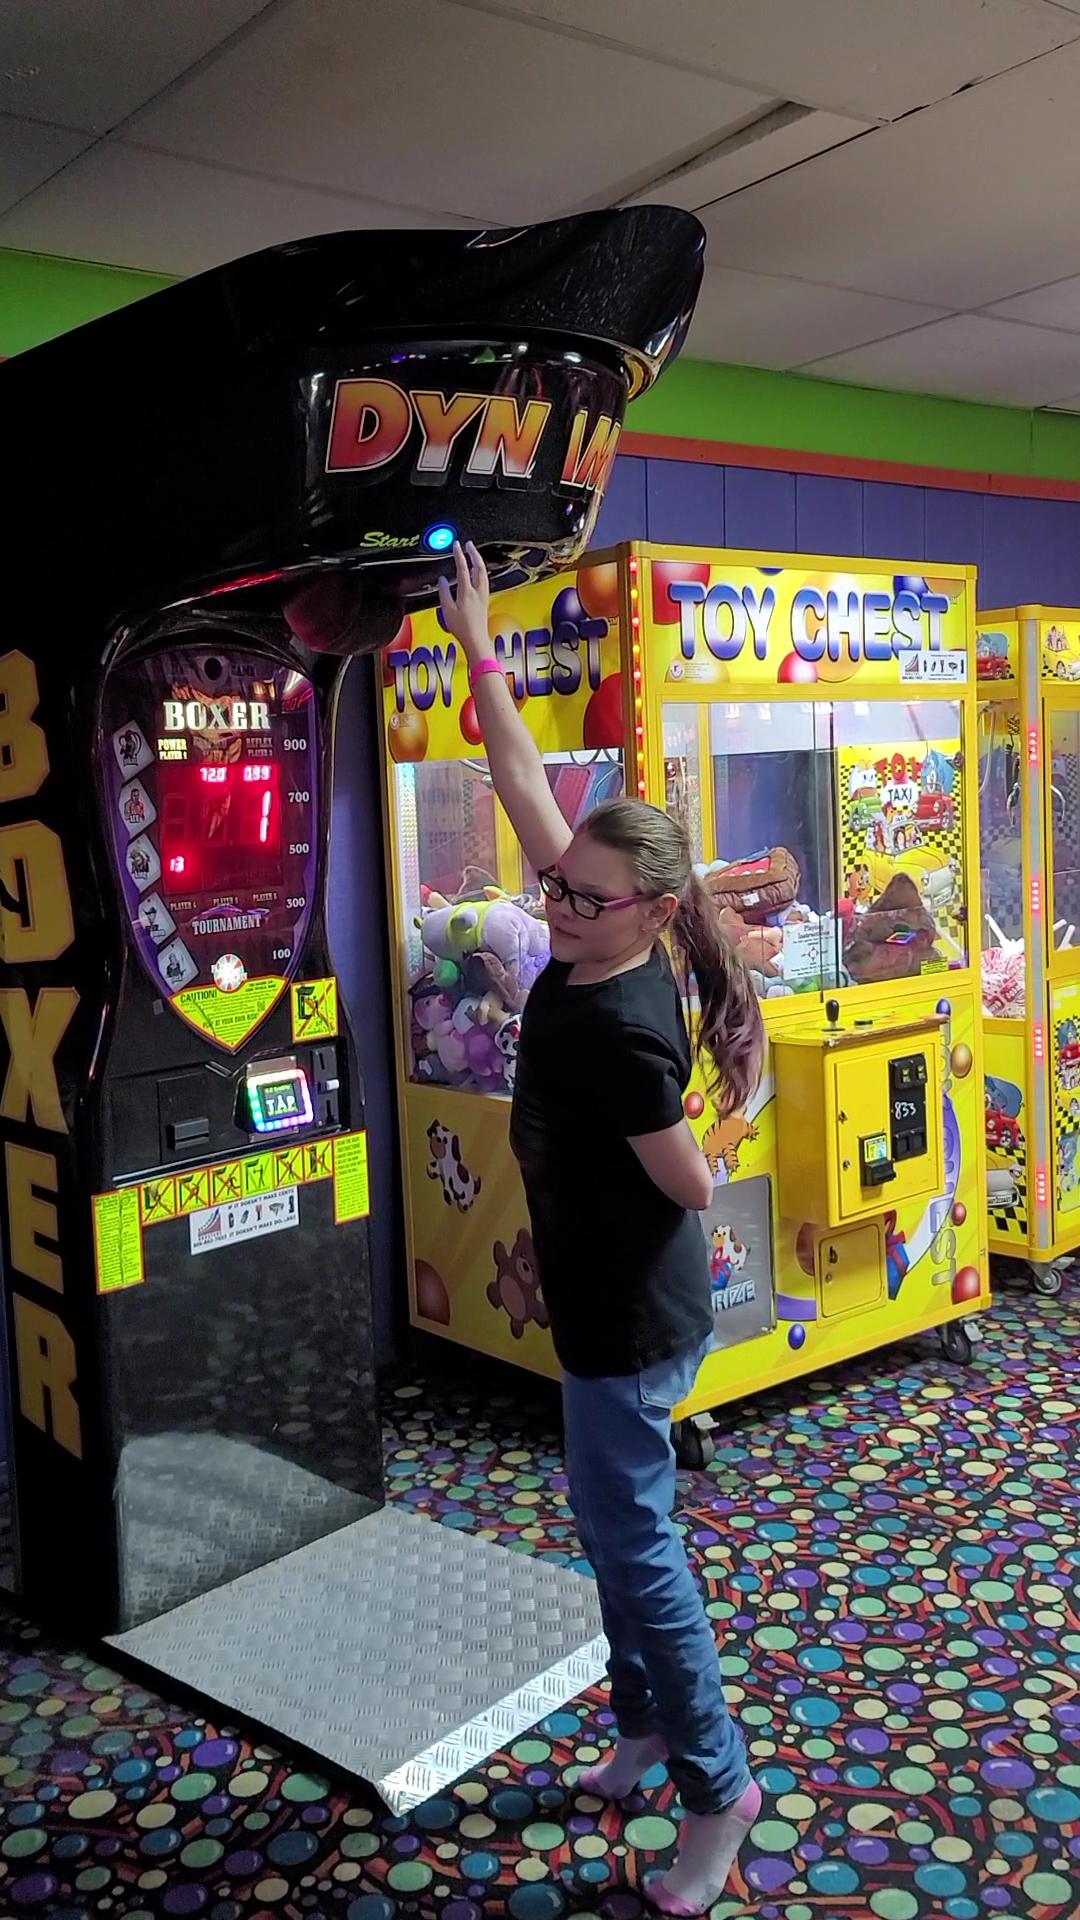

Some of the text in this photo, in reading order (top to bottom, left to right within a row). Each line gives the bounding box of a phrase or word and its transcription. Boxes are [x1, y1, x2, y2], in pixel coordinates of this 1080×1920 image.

[359, 531, 420, 549] Start
[667, 581, 950, 662] TOY CHEST
[387, 617, 610, 713] TOY HEST
[163, 701, 271, 731] BOXER
[157, 738, 188, 751] POWER
[283, 738, 307, 751] 900
[288, 791, 310, 803] 700
[888, 787, 913, 803] TAXI
[288, 843, 310, 855] 500
[286, 897, 306, 909] 300
[192, 914, 262, 935] TOURNAMENT
[272, 949, 291, 960] 100
[180, 989, 218, 1004] CAUTION!
[265, 1094, 296, 1115] TAP
[895, 1101, 917, 1120] 833
